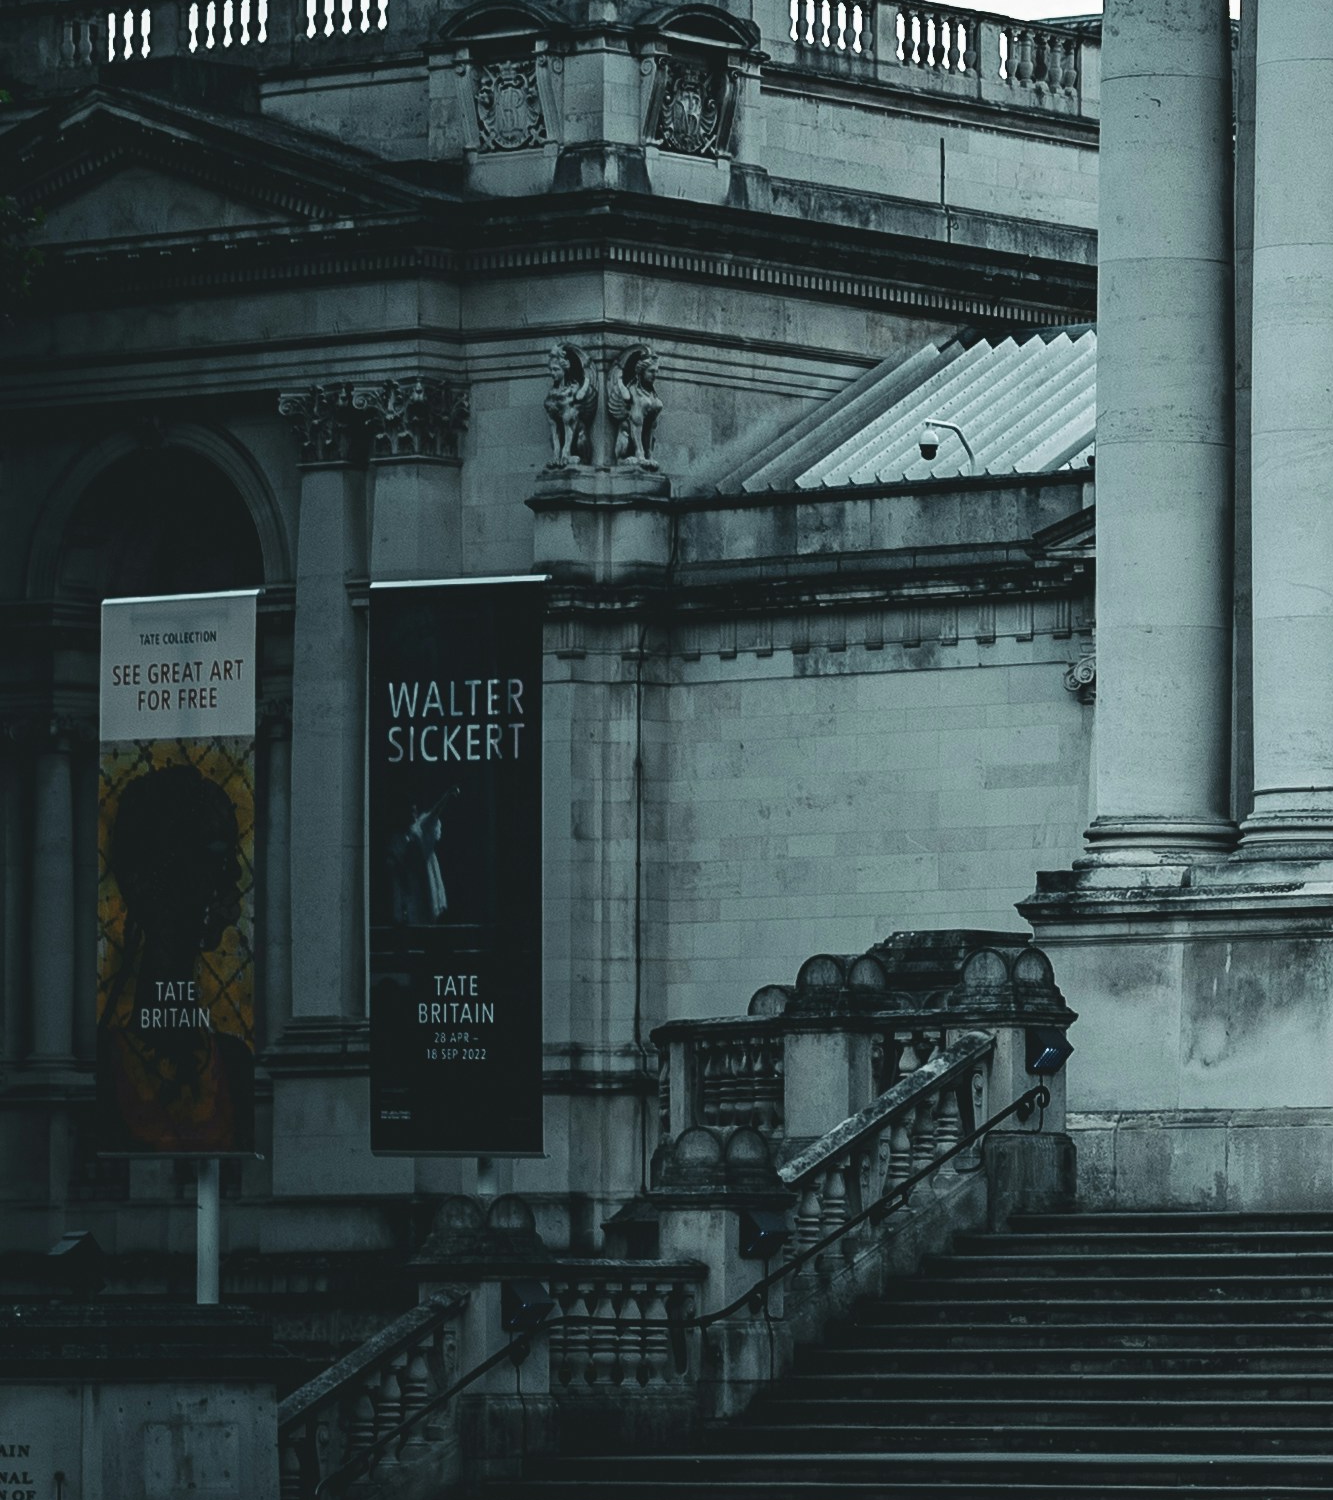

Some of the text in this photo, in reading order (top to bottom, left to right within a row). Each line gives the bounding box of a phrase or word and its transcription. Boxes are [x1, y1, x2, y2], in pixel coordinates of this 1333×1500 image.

[139, 631, 217, 646] TATE COLLECTION
[112, 659, 244, 686] SEE GREAT ART
[137, 687, 217, 711] FOR FREE
[388, 678, 524, 719] WALTER
[387, 722, 525, 763] SICKERT
[155, 981, 196, 1001] TATE
[434, 975, 479, 997] TATE
[140, 1007, 211, 1029] BRITAIN
[418, 1002, 494, 1024] BRITAIN
[434, 1032, 447, 1044] 28
[449, 1031, 470, 1043] APR
[426, 1048, 487, 1060] 18 SEP 2022
